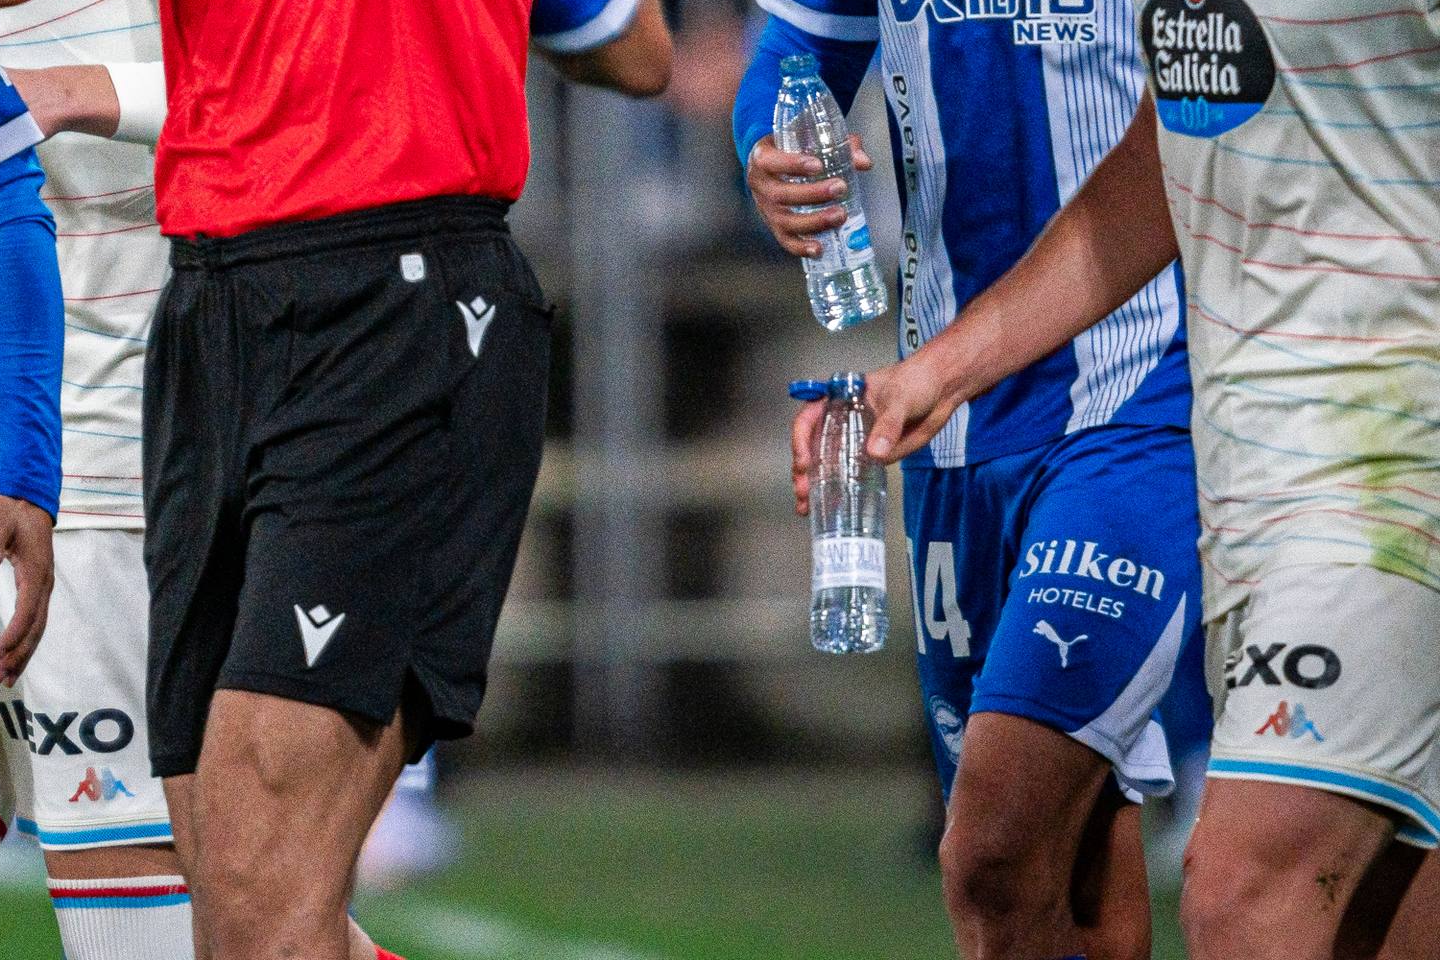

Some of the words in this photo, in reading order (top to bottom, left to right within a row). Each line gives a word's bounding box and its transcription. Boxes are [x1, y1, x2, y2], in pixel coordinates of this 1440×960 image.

[1016, 22, 1096, 42] NEWS
[1152, 7, 1244, 54] Estrella
[1154, 48, 1242, 96] Galicia
[903, 230, 920, 351] araba
[1019, 539, 1165, 601] Silken
[903, 536, 972, 658] 14
[1027, 587, 1126, 619] HOTELES
